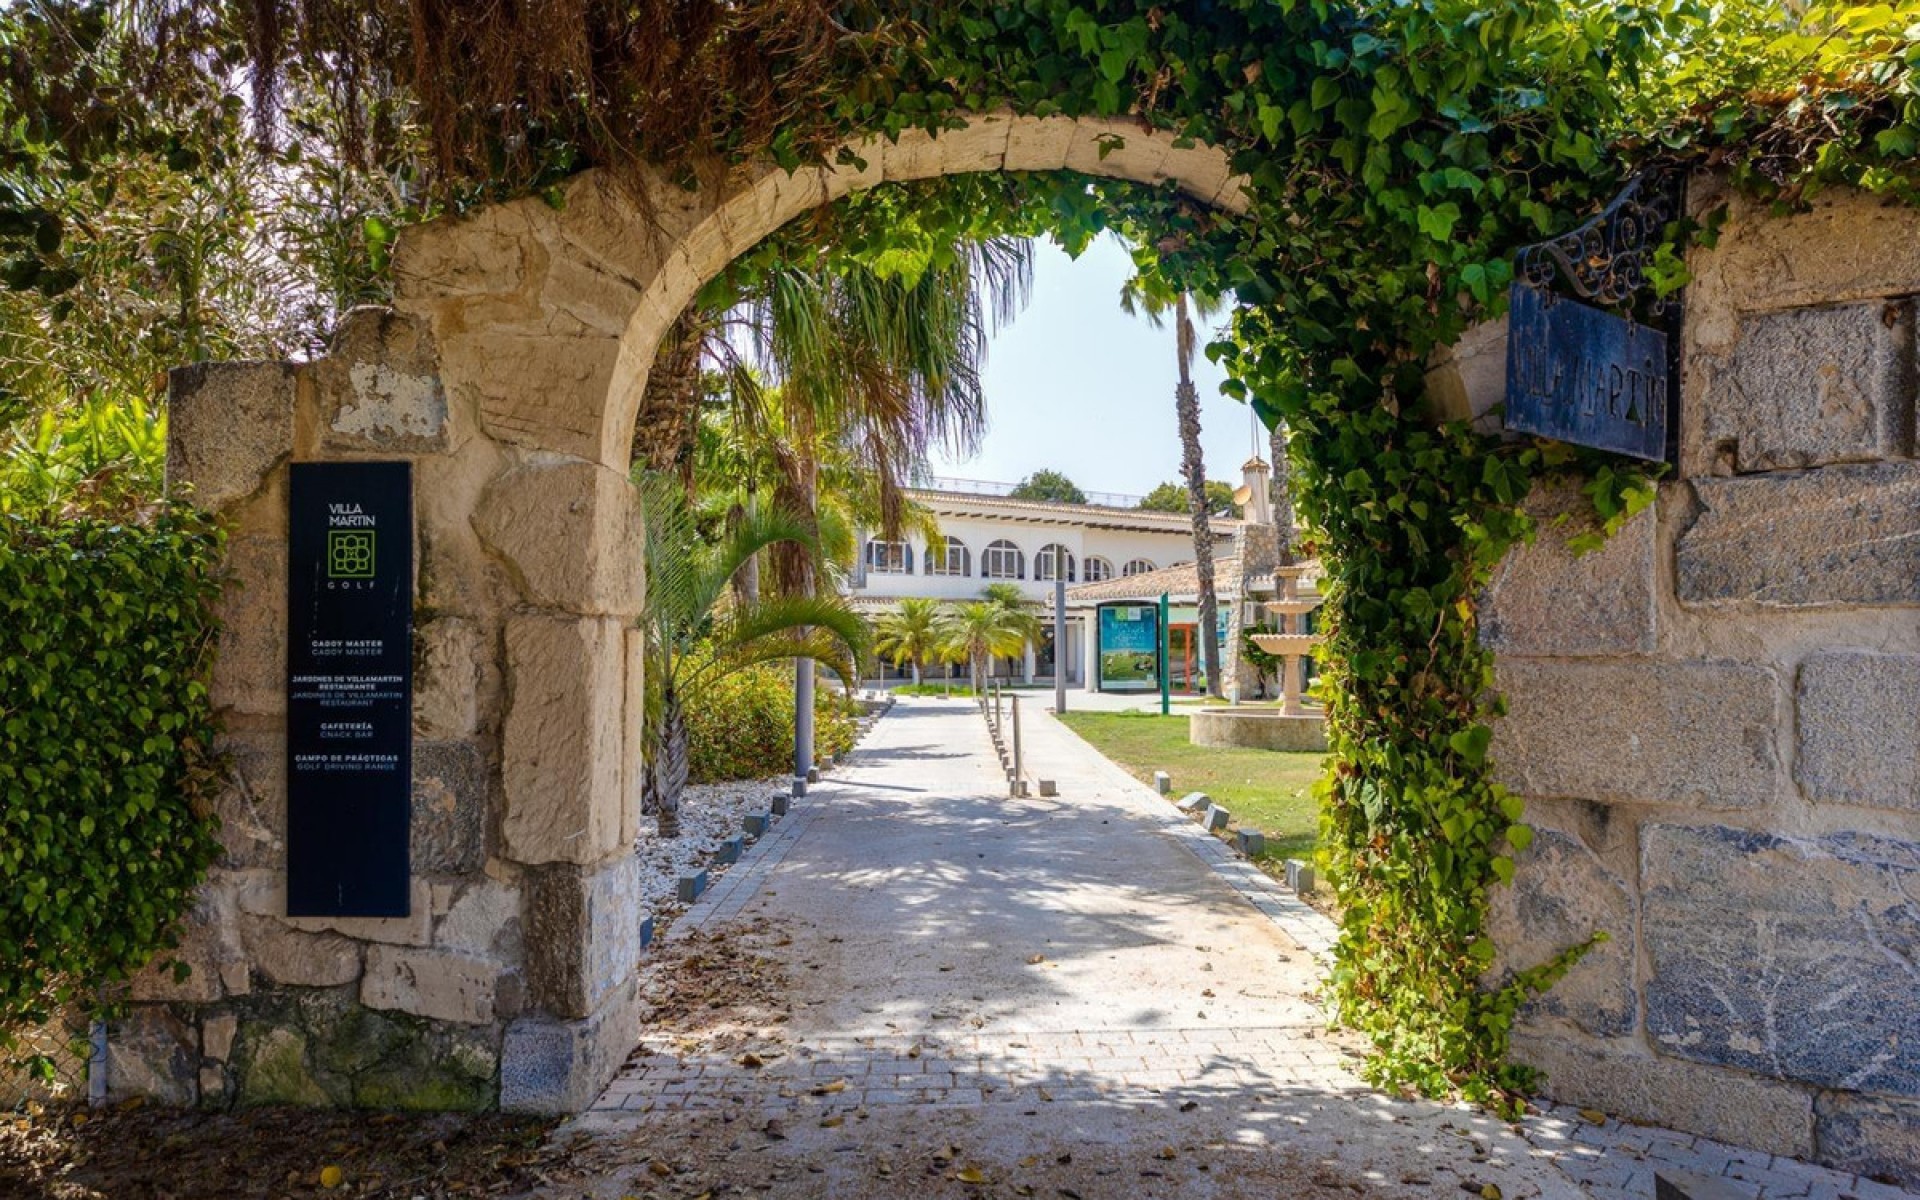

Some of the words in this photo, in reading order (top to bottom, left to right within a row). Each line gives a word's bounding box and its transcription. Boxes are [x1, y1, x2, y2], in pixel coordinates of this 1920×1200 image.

[328, 503, 363, 514] VILLA
[328, 515, 376, 526] MARTIN
[327, 581, 375, 590] GOLF
[311, 648, 343, 656] CADDY
[345, 648, 383, 656] MASTER
[292, 691, 332, 699] JARDINES
[334, 691, 345, 699] DE
[320, 699, 374, 707] RESTAURANT
[320, 721, 373, 730] CAFETERÍA
[345, 753, 398, 762] PRÁCTICAS
